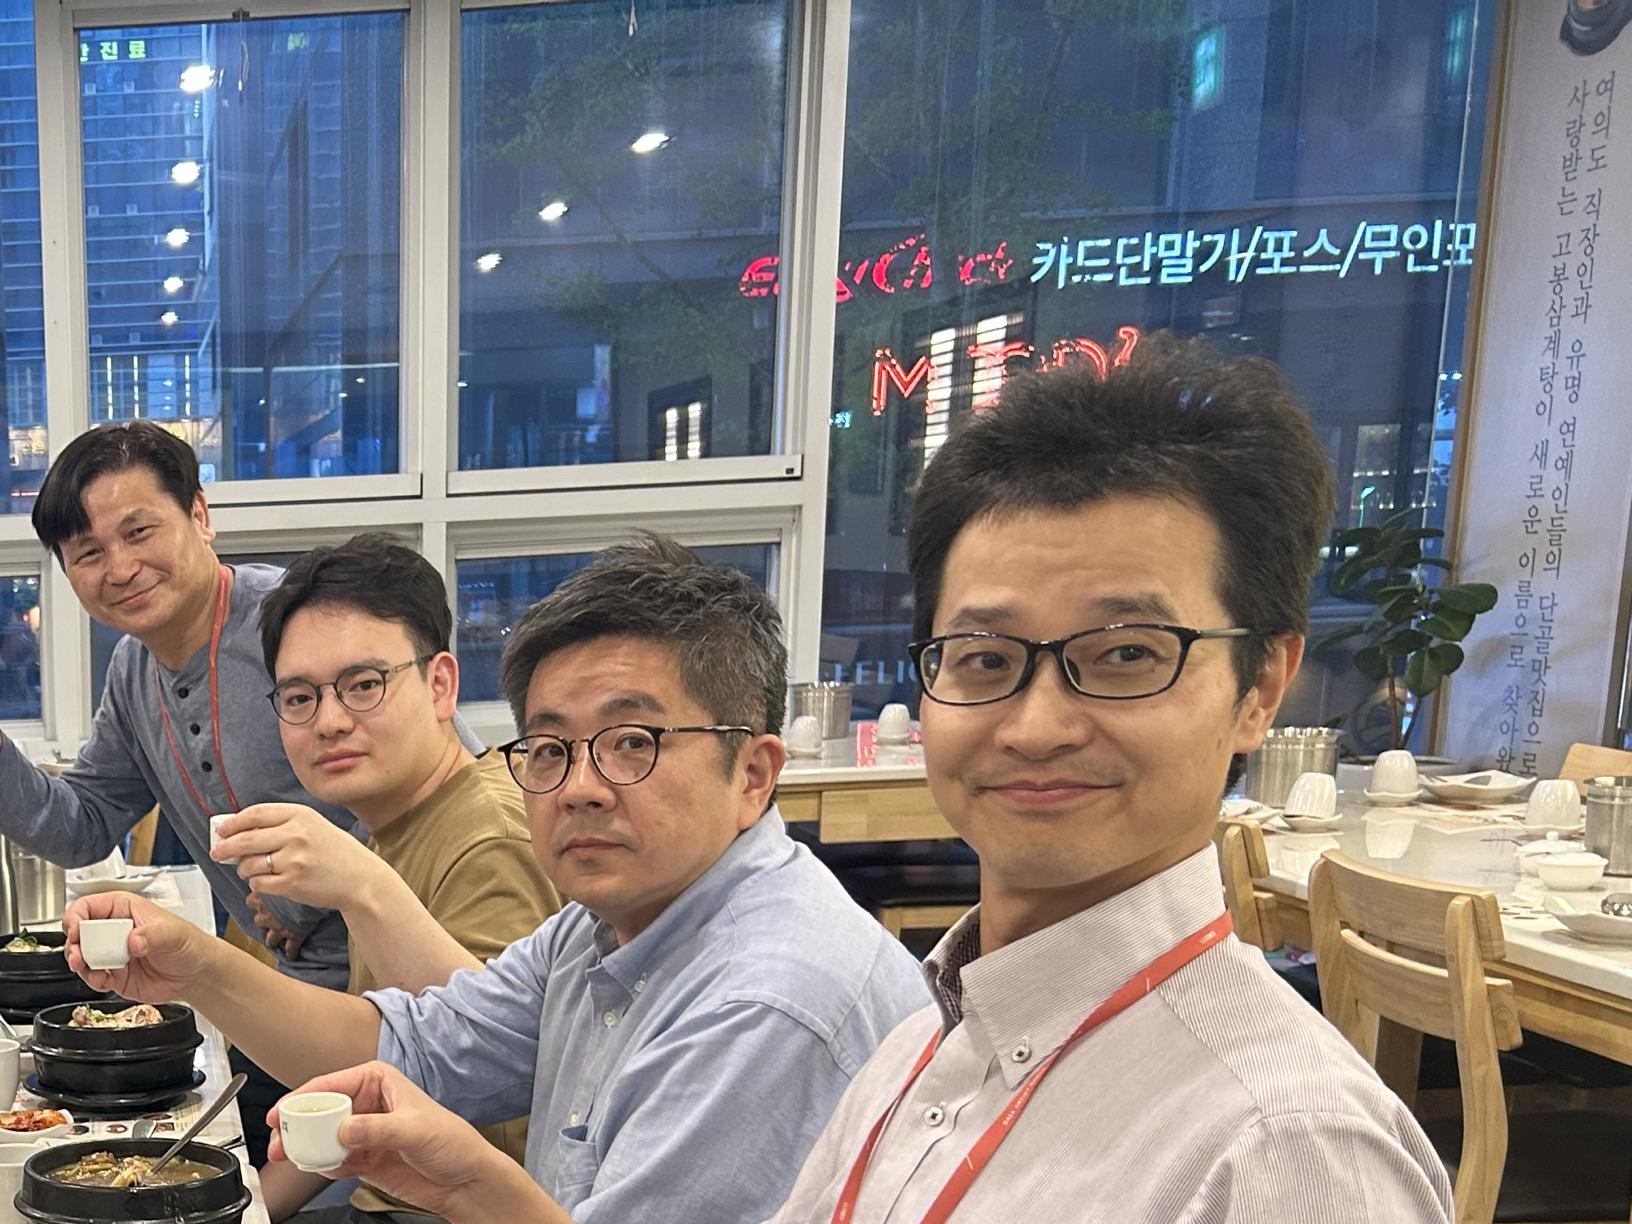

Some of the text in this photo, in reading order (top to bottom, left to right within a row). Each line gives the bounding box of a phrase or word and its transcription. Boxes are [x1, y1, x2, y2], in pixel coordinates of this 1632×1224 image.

[1557, 79, 1590, 217] 사랑받는
[1535, 233, 1572, 427] 고봉삼계탕이
[1519, 70, 1616, 778] 여의도 직장인과 유명 연예인들의 단골맛집으로
[1522, 438, 1550, 536] 새로운
[1506, 547, 1537, 669] 이름으로
